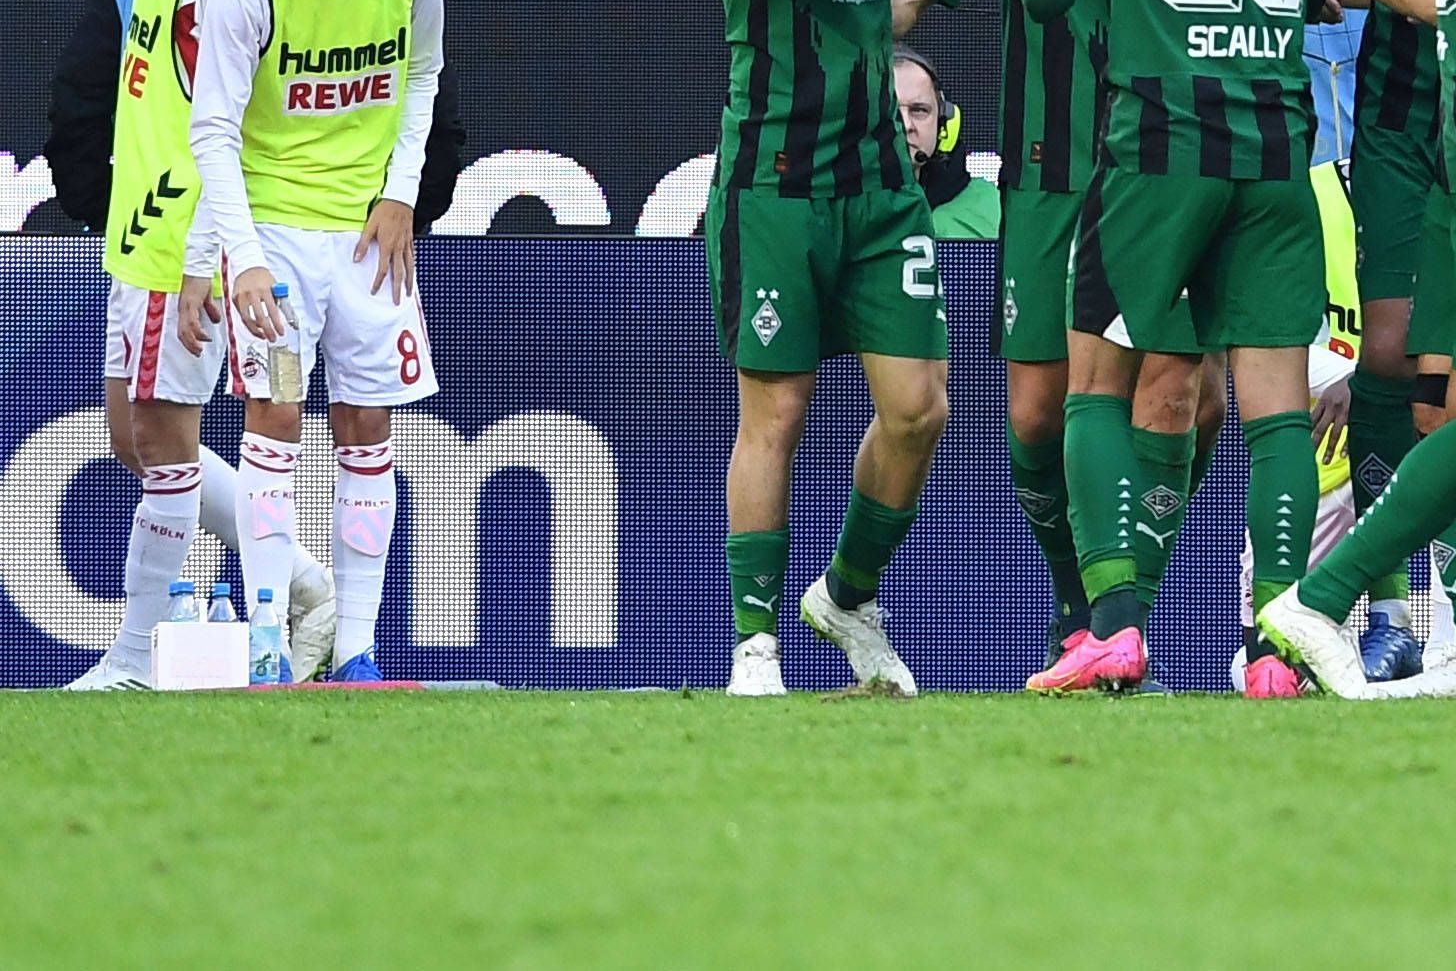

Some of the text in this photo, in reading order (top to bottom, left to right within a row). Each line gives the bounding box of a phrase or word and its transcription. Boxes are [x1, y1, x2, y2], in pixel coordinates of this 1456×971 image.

[278, 27, 406, 75] hummel
[1187, 25, 1293, 60] SCALLY
[287, 73, 392, 110] REWE
[397, 329, 422, 385] 8
[150, 524, 186, 541] KÖLN
